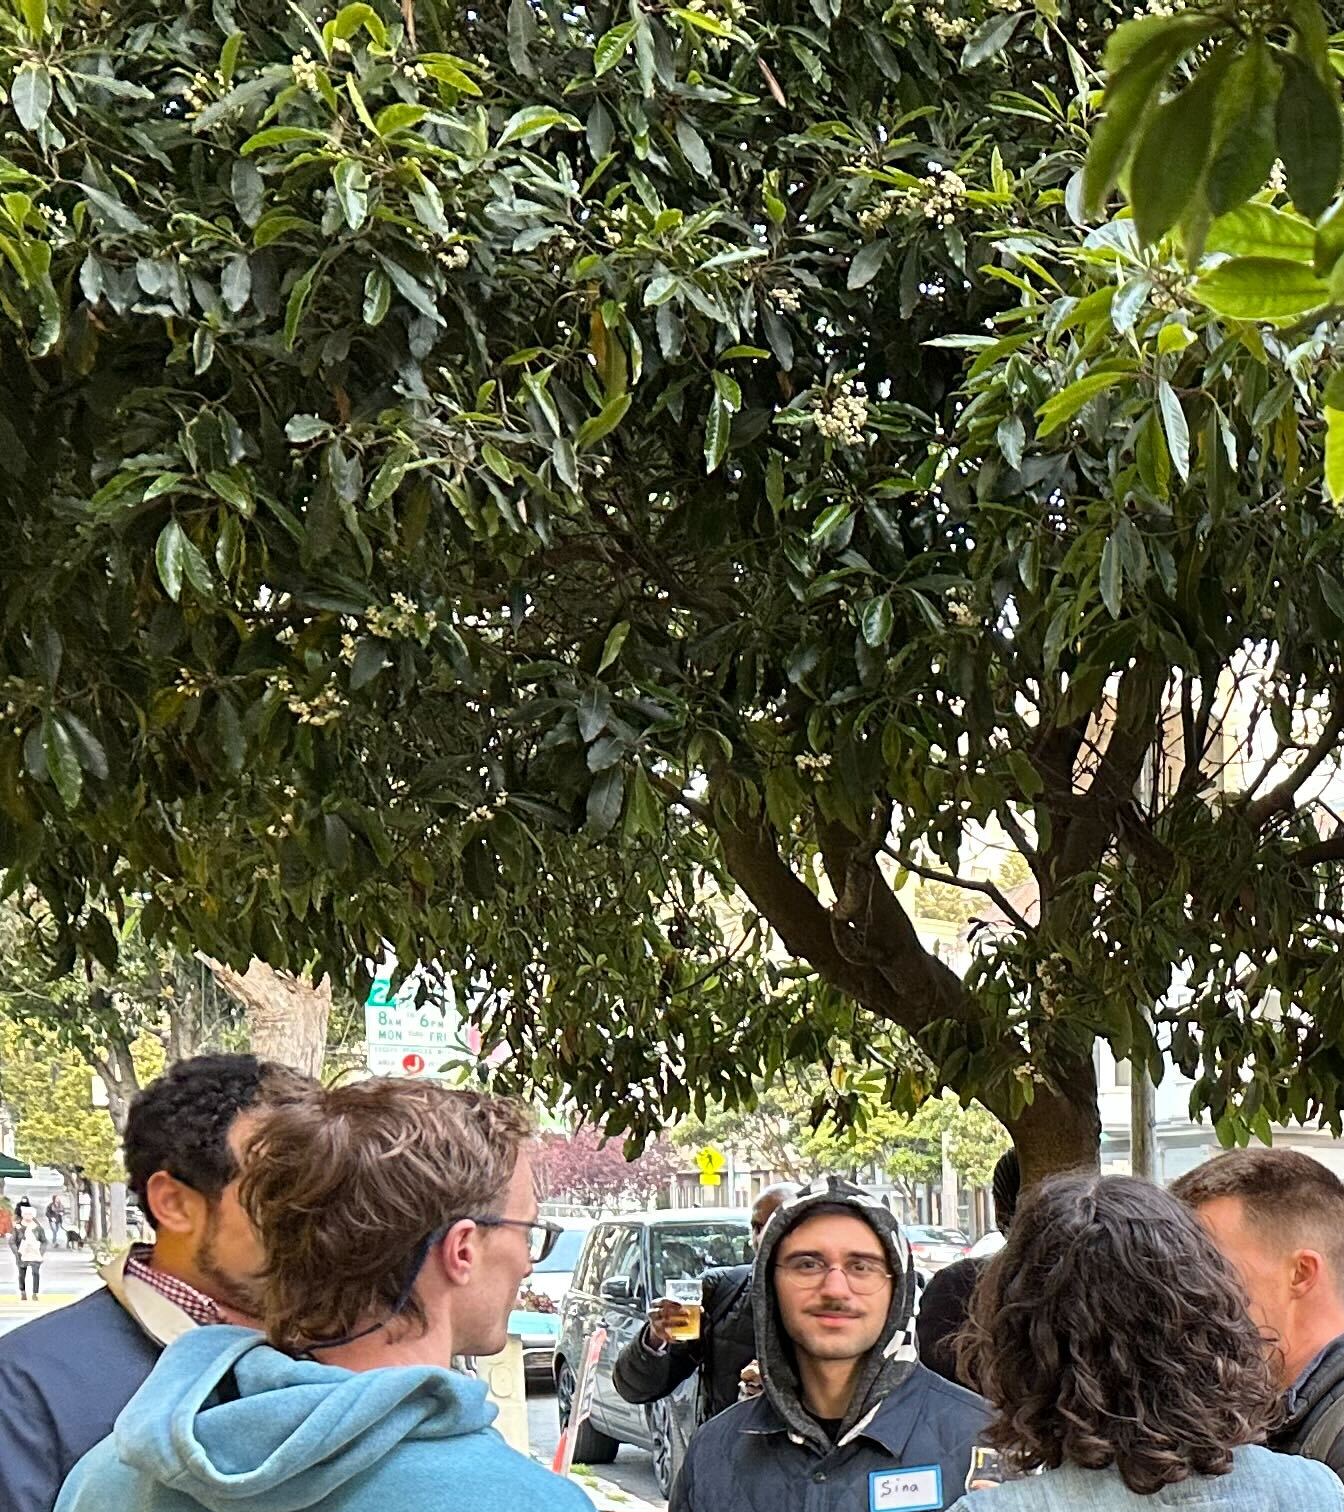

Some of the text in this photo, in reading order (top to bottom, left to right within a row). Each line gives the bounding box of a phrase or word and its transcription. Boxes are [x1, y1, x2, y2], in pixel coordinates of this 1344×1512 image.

[378, 1030, 402, 1041] MON
[429, 1032, 447, 1042] FRI
[880, 1477, 919, 1498] Sina
